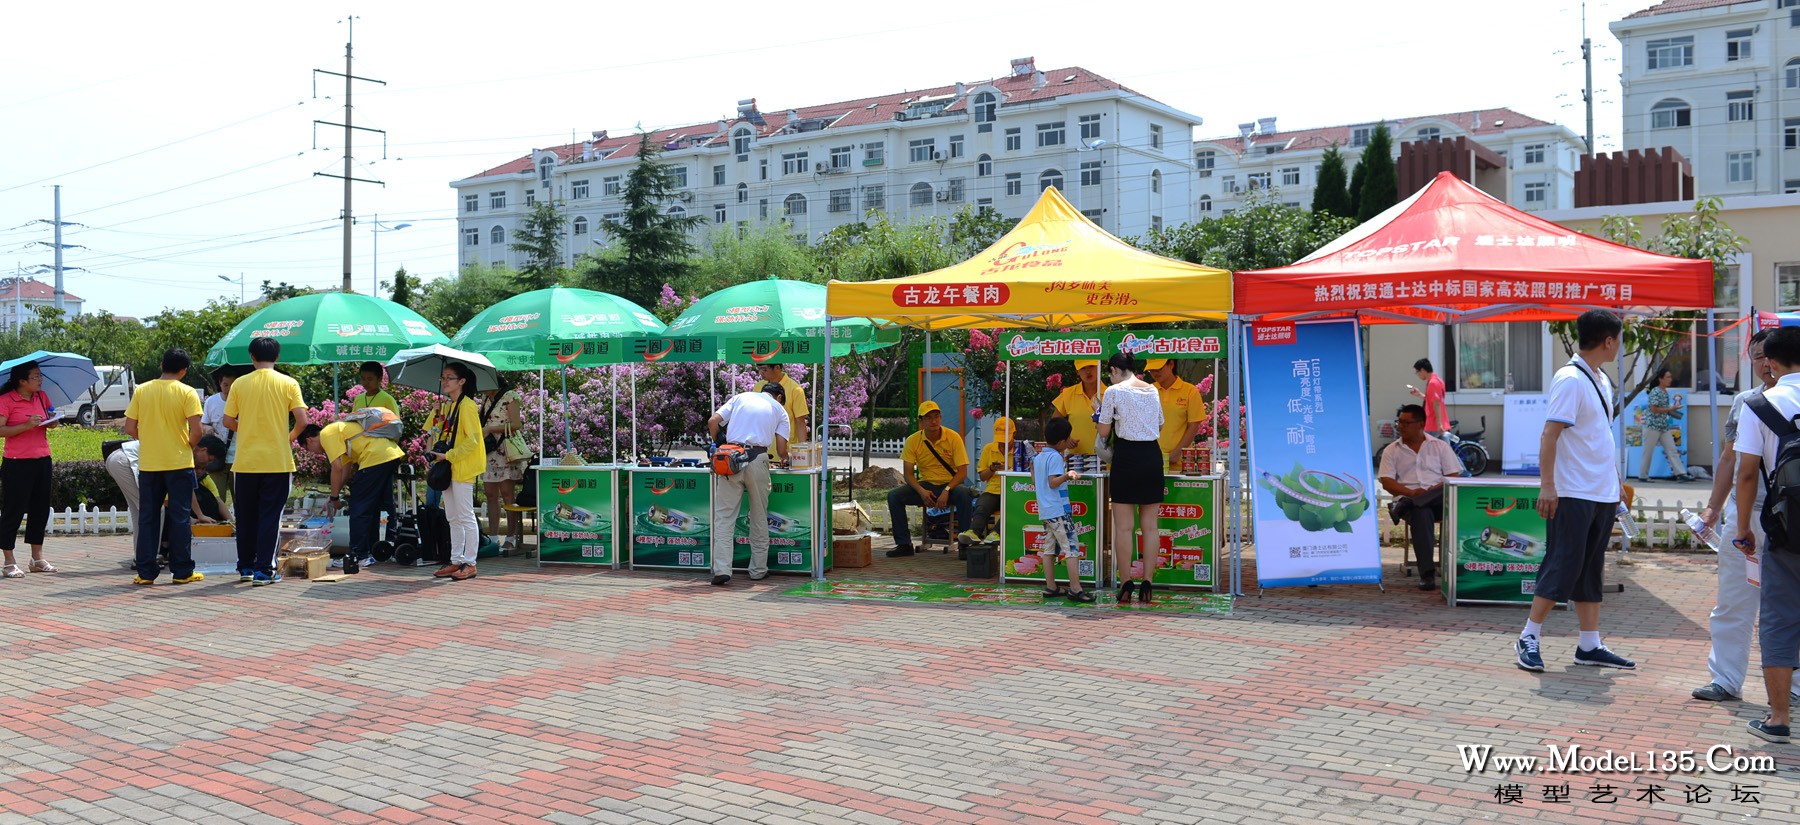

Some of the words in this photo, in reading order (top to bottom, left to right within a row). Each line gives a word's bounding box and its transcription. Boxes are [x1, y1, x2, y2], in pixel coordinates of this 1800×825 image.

[1344, 236, 1460, 258] TOPSTAR
[1475, 234, 1576, 247] 通士达照明
[903, 285, 1000, 305] 古龙午餐肉
[1314, 280, 1634, 303] 热烈祝贺通士达中标国家高效照明推广项目
[335, 344, 387, 356] 碱性电池
[549, 341, 609, 356] 三圈霸道
[634, 338, 702, 354] 三圈霸道
[742, 340, 810, 355] 三圈霸道
[1040, 339, 1101, 354] 古龙食品
[1154, 337, 1219, 353] 古龙食品
